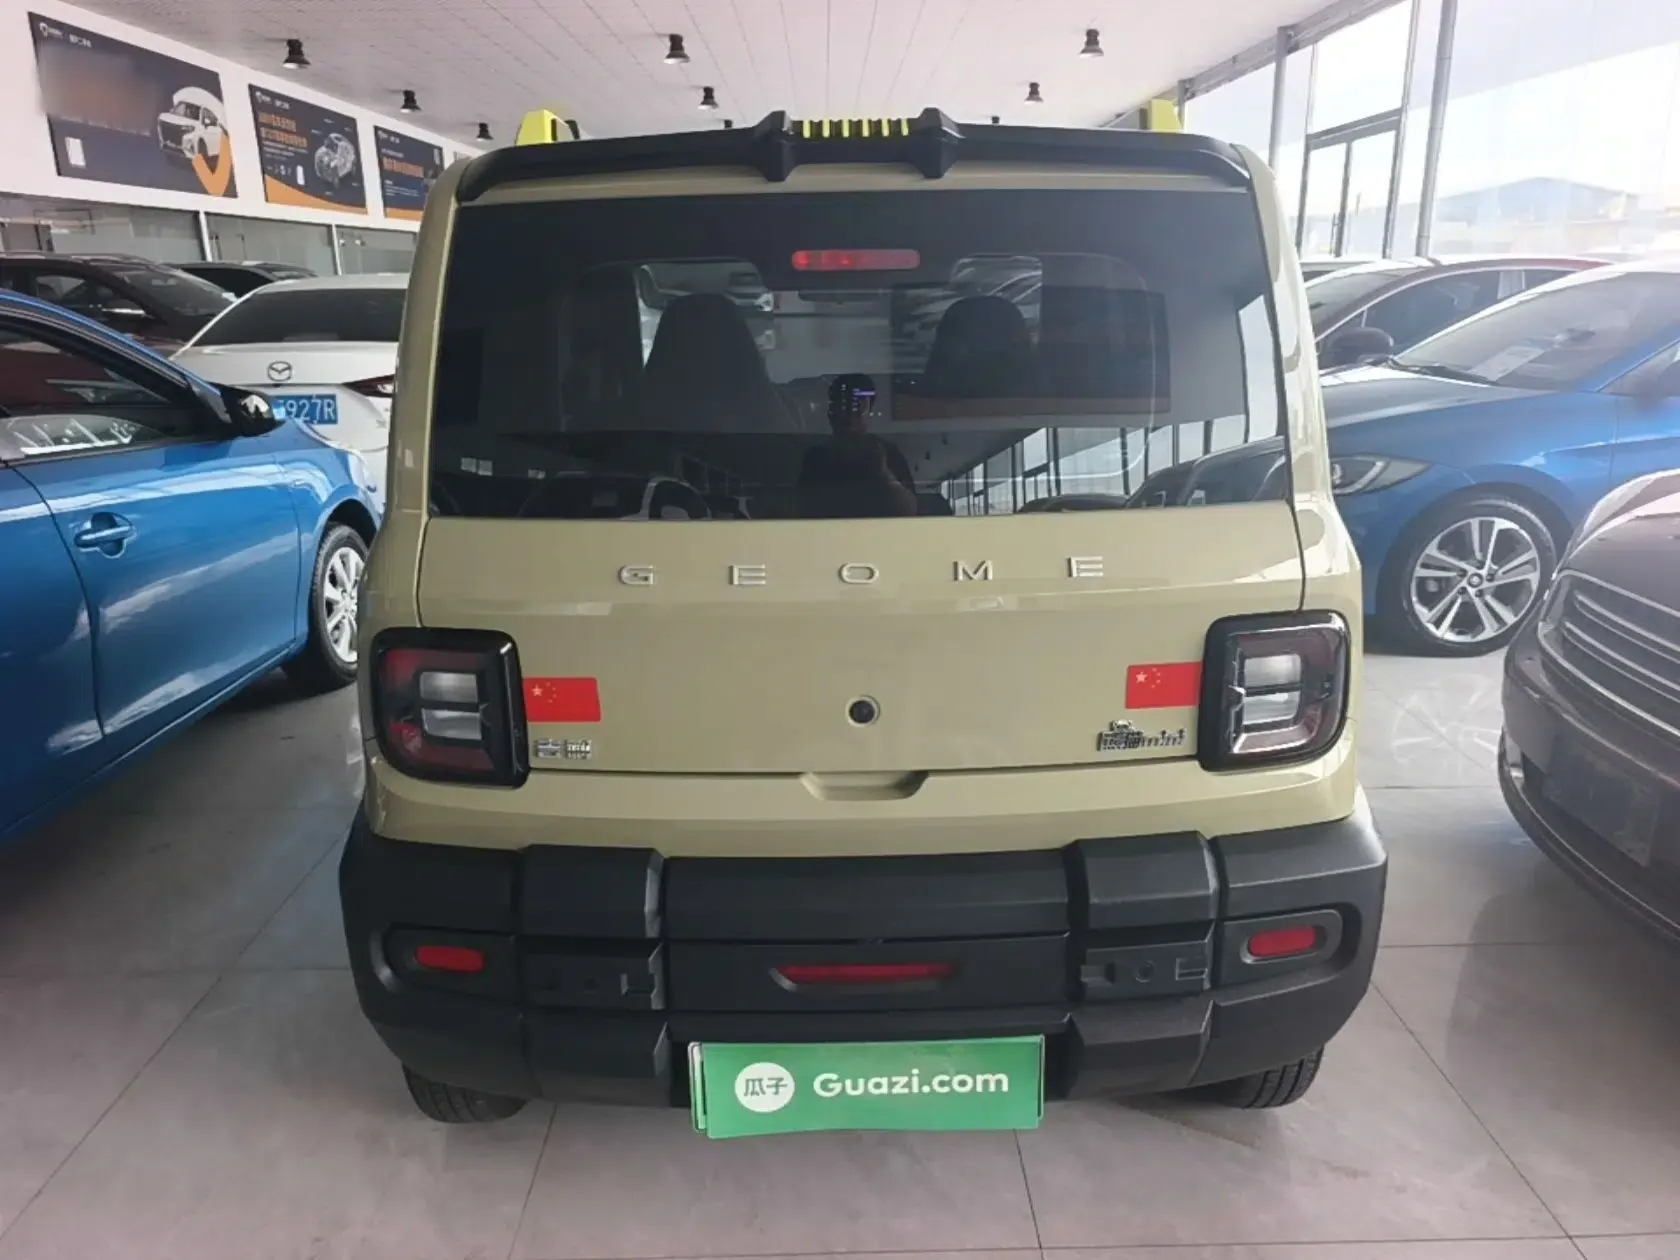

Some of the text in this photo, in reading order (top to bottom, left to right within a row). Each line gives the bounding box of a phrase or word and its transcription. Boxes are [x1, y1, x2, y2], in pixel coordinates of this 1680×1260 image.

[279, 398, 336, 421] 927R
[618, 556, 1104, 586] GEOME
[742, 1068, 1009, 1098] 瓜子 Guazi.com
